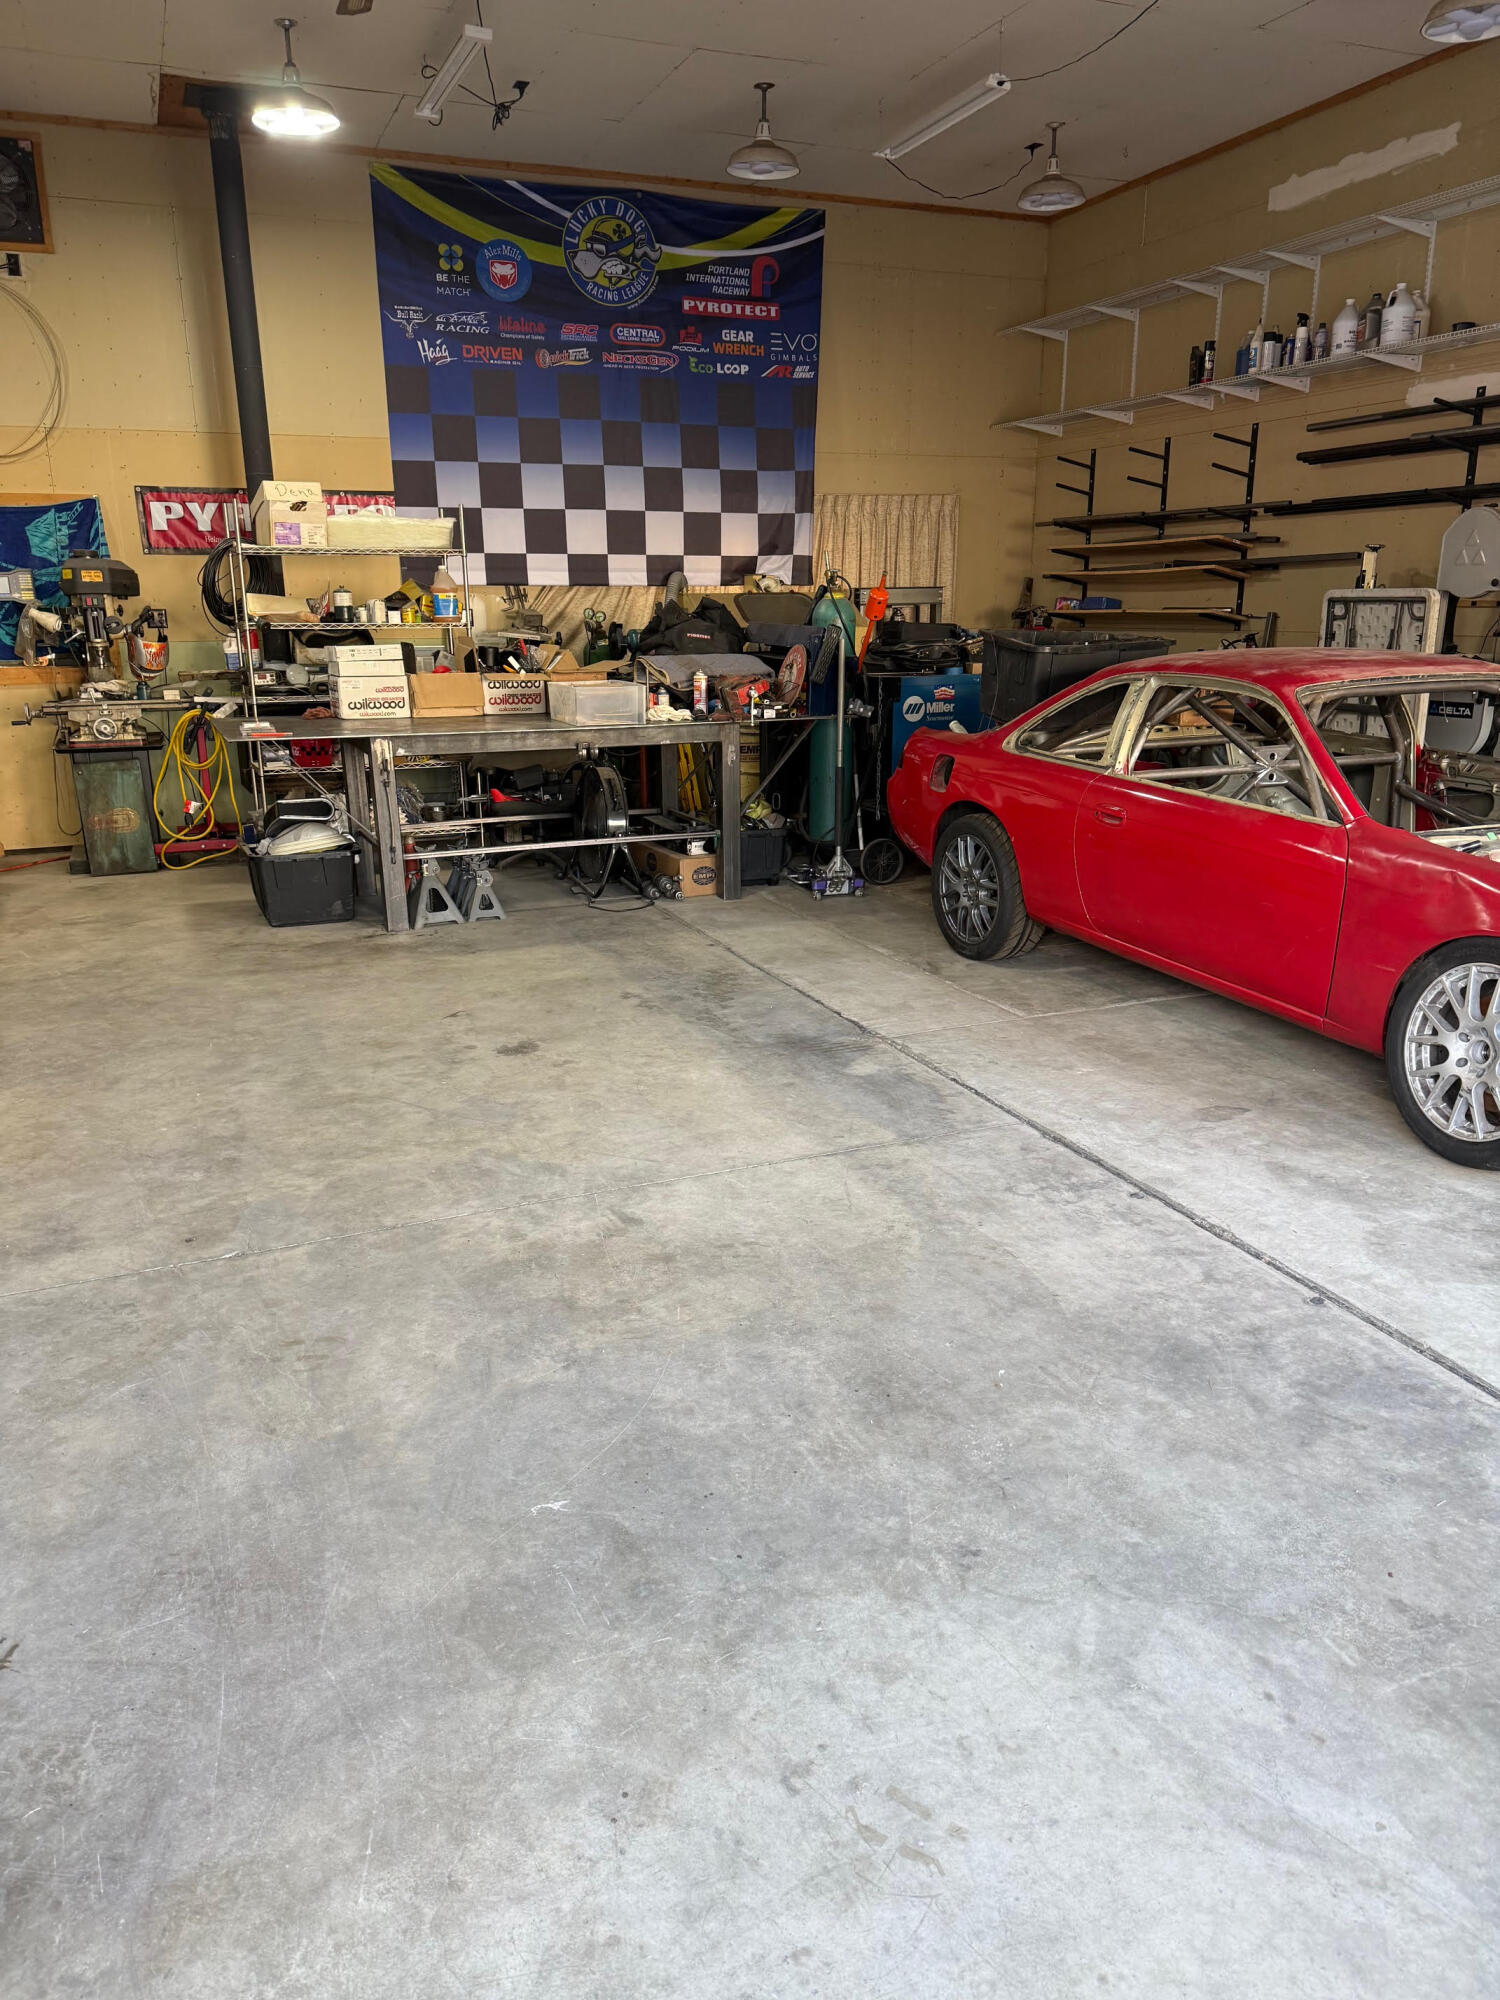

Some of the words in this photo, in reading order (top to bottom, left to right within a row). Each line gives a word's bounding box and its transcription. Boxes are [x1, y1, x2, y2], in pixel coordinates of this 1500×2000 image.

[565, 199, 606, 245] LUCKY
[615, 201, 646, 233] DOG
[484, 246, 501, 260] Alex
[502, 244, 523, 262] Mills
[707, 264, 750, 277] PORTLAND
[436, 273, 449, 283] BE
[452, 274, 471, 284] THE
[685, 273, 750, 287] INTERNATIONAL
[436, 286, 471, 297] MATCH
[586, 282, 619, 302] RACING
[621, 272, 649, 300] LEAGUE
[712, 285, 750, 297] RACEWAY
[683, 299, 779, 317] PYROTECT
[435, 323, 490, 334] RACING
[616, 327, 660, 339] CENTRAL
[721, 329, 754, 343] GEAR
[770, 332, 817, 352] EVO
[462, 344, 523, 363] DRIVEN
[712, 341, 765, 357] WRENCH
[770, 353, 818, 362] GIMBALS
[487, 679, 542, 690] wilwood
[347, 696, 406, 711] wilwood
[488, 692, 542, 706] wilwood
[926, 701, 956, 714] Miller
[1438, 705, 1471, 716] DELTA
